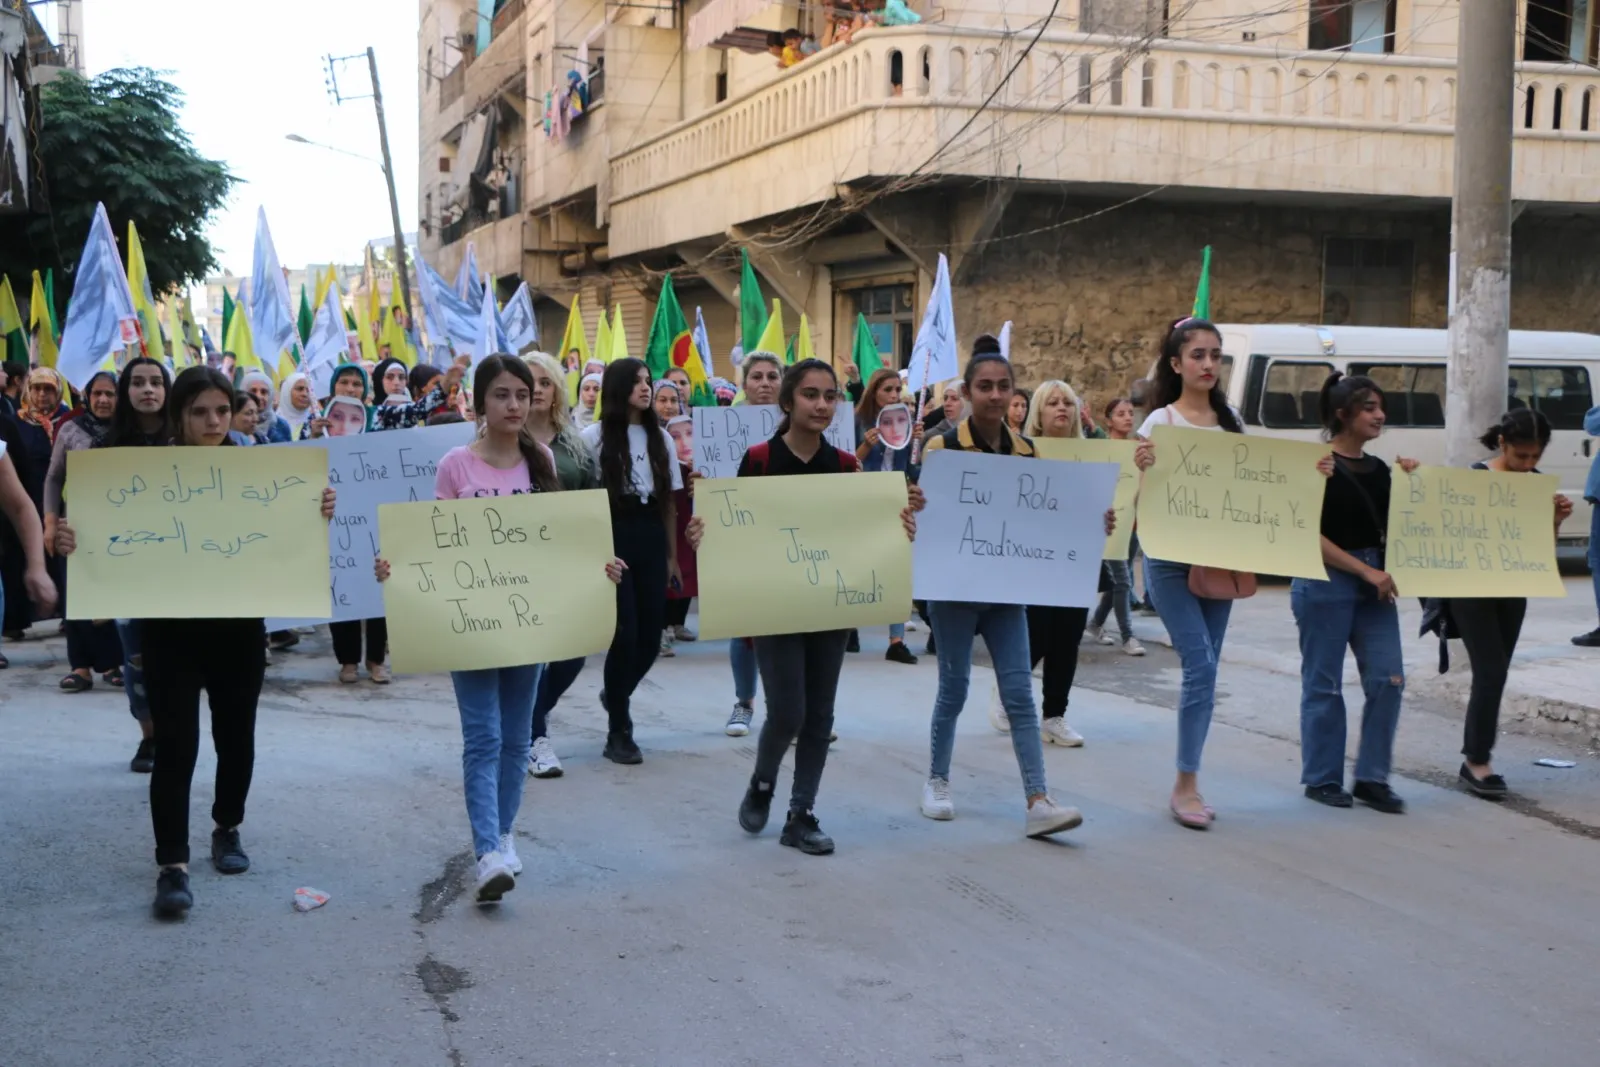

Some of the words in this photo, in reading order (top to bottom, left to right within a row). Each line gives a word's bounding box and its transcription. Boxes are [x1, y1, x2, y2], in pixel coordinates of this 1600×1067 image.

[701, 409, 714, 439] Li
[348, 451, 390, 482] Jînê
[1174, 443, 1213, 477] Xwe
[1232, 442, 1288, 485] Parastin
[106, 474, 148, 508] هي
[161, 464, 224, 504] المرأة
[240, 475, 307, 507] حرية
[958, 471, 992, 506] Ew
[1016, 473, 1058, 512] Rola
[709, 488, 755, 527] Jin
[1288, 499, 1306, 529] Ye
[107, 516, 188, 557] المجتمع
[200, 532, 269, 559] حرية
[431, 506, 469, 549] Êdî
[483, 507, 527, 545] Bes
[539, 524, 552, 541] e
[779, 528, 830, 586] Jiyan
[1067, 549, 1077, 561] e
[409, 561, 437, 592] Ji
[454, 558, 530, 590] Qirkirina
[835, 569, 884, 606] Azadî
[446, 598, 502, 634] Jinan
[508, 593, 544, 628] Re
